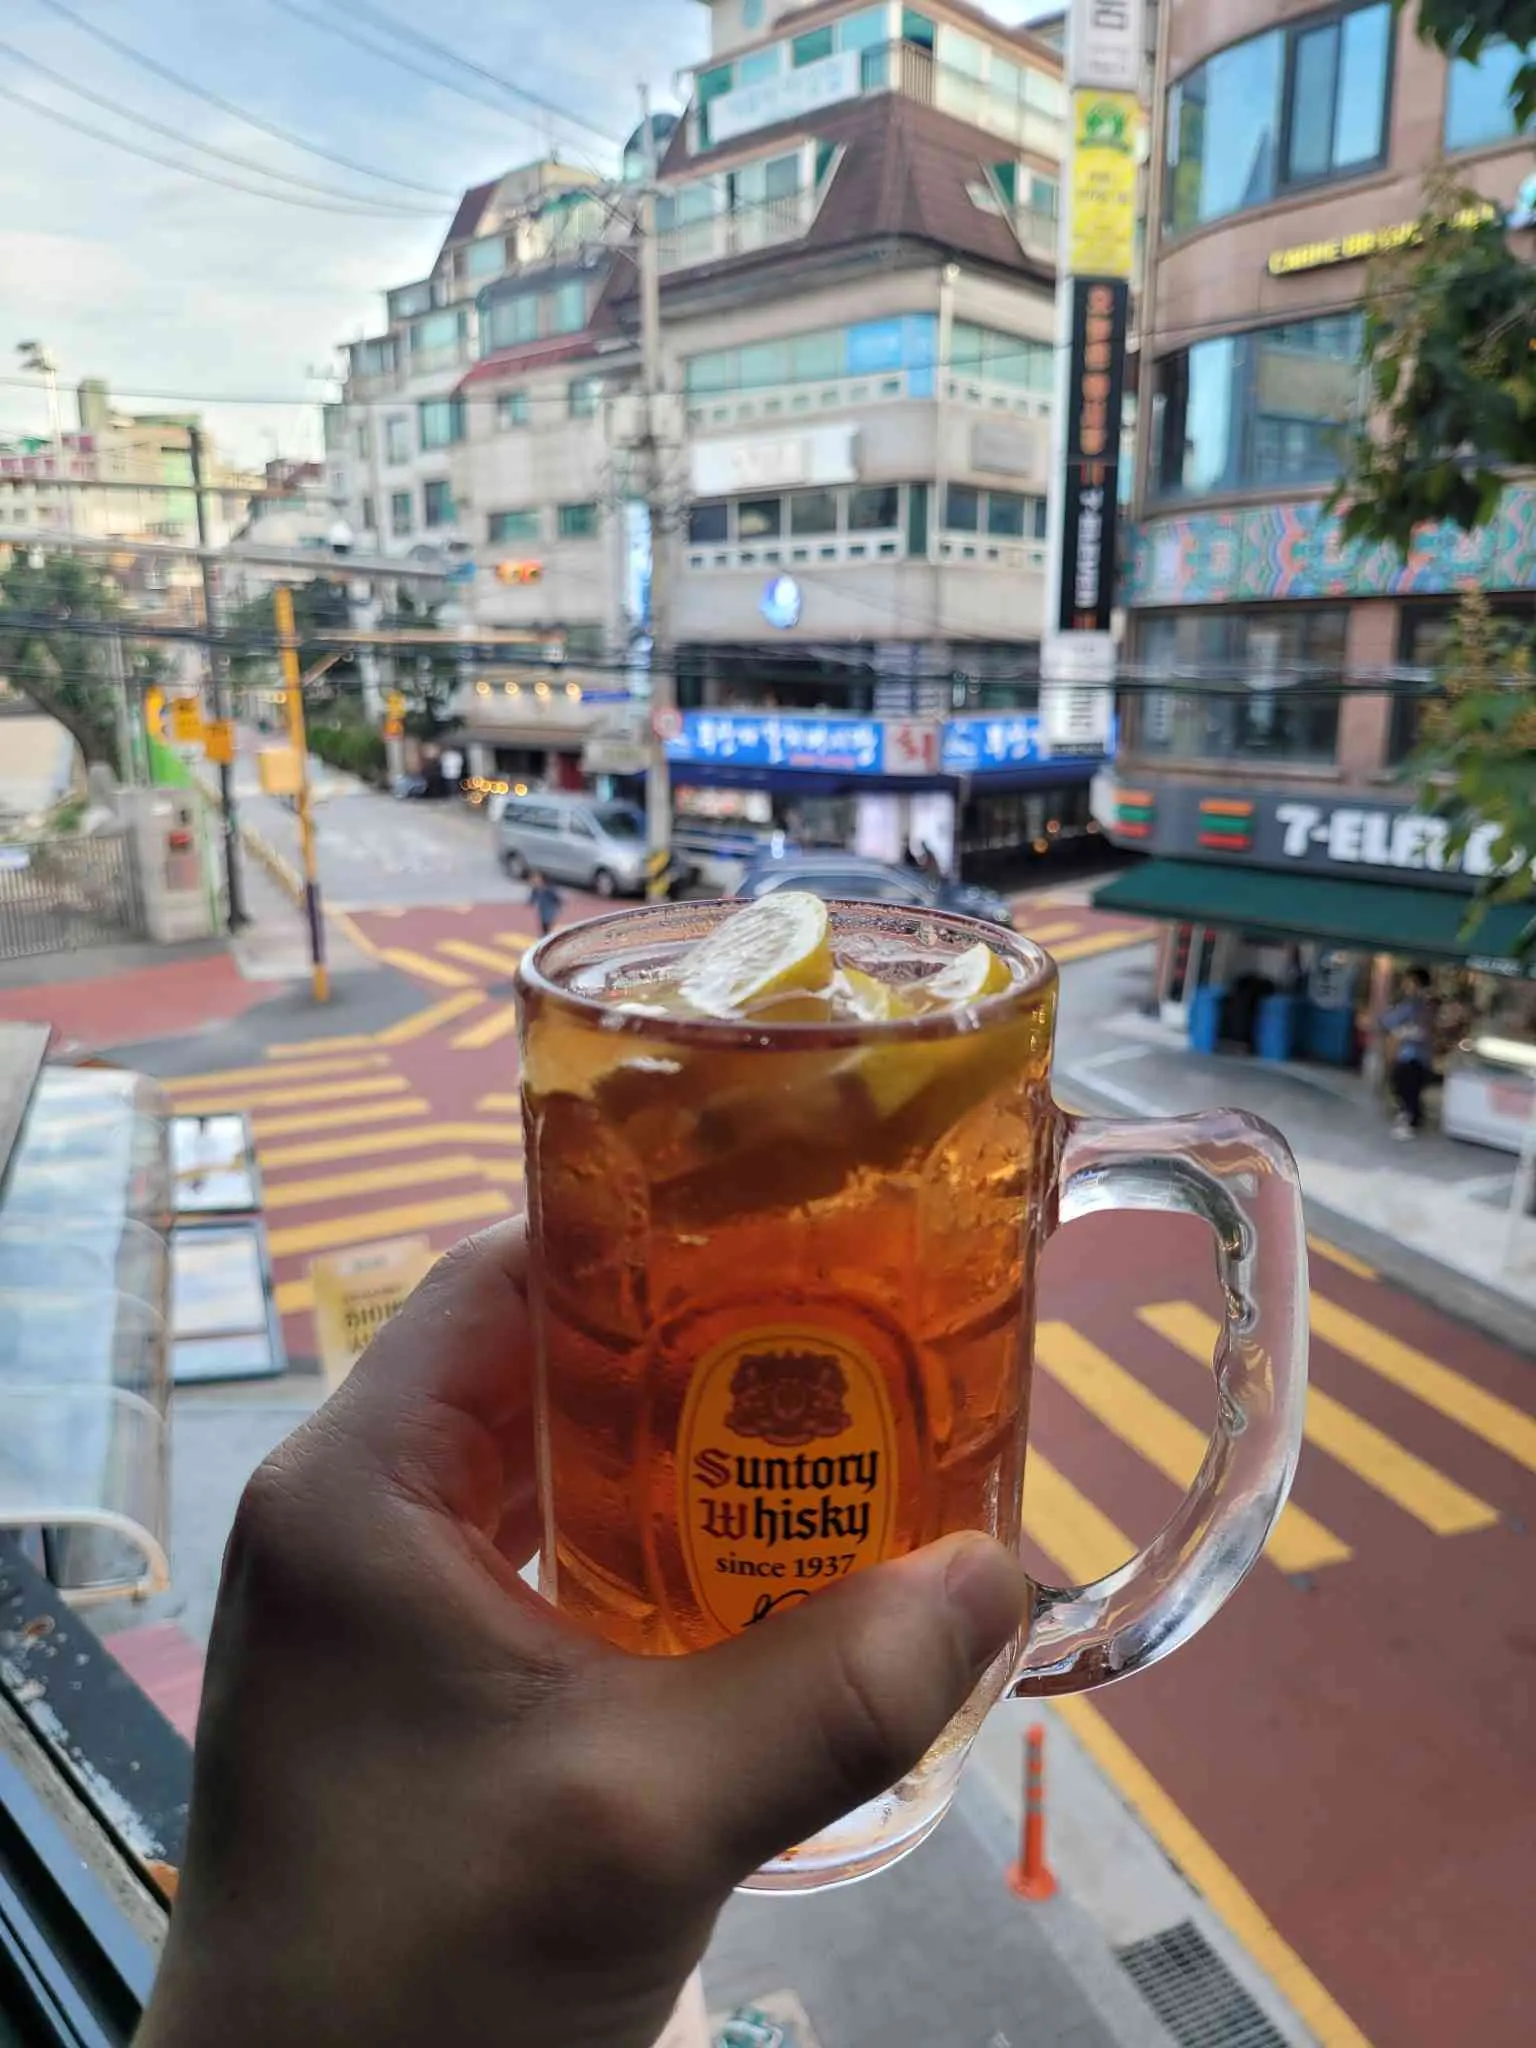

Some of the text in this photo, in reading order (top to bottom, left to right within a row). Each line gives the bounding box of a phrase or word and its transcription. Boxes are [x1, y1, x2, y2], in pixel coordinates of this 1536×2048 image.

[693, 1447, 879, 1493] Suntory
[698, 1495, 871, 1548] Whisky
[715, 1551, 856, 1579] since 1937
